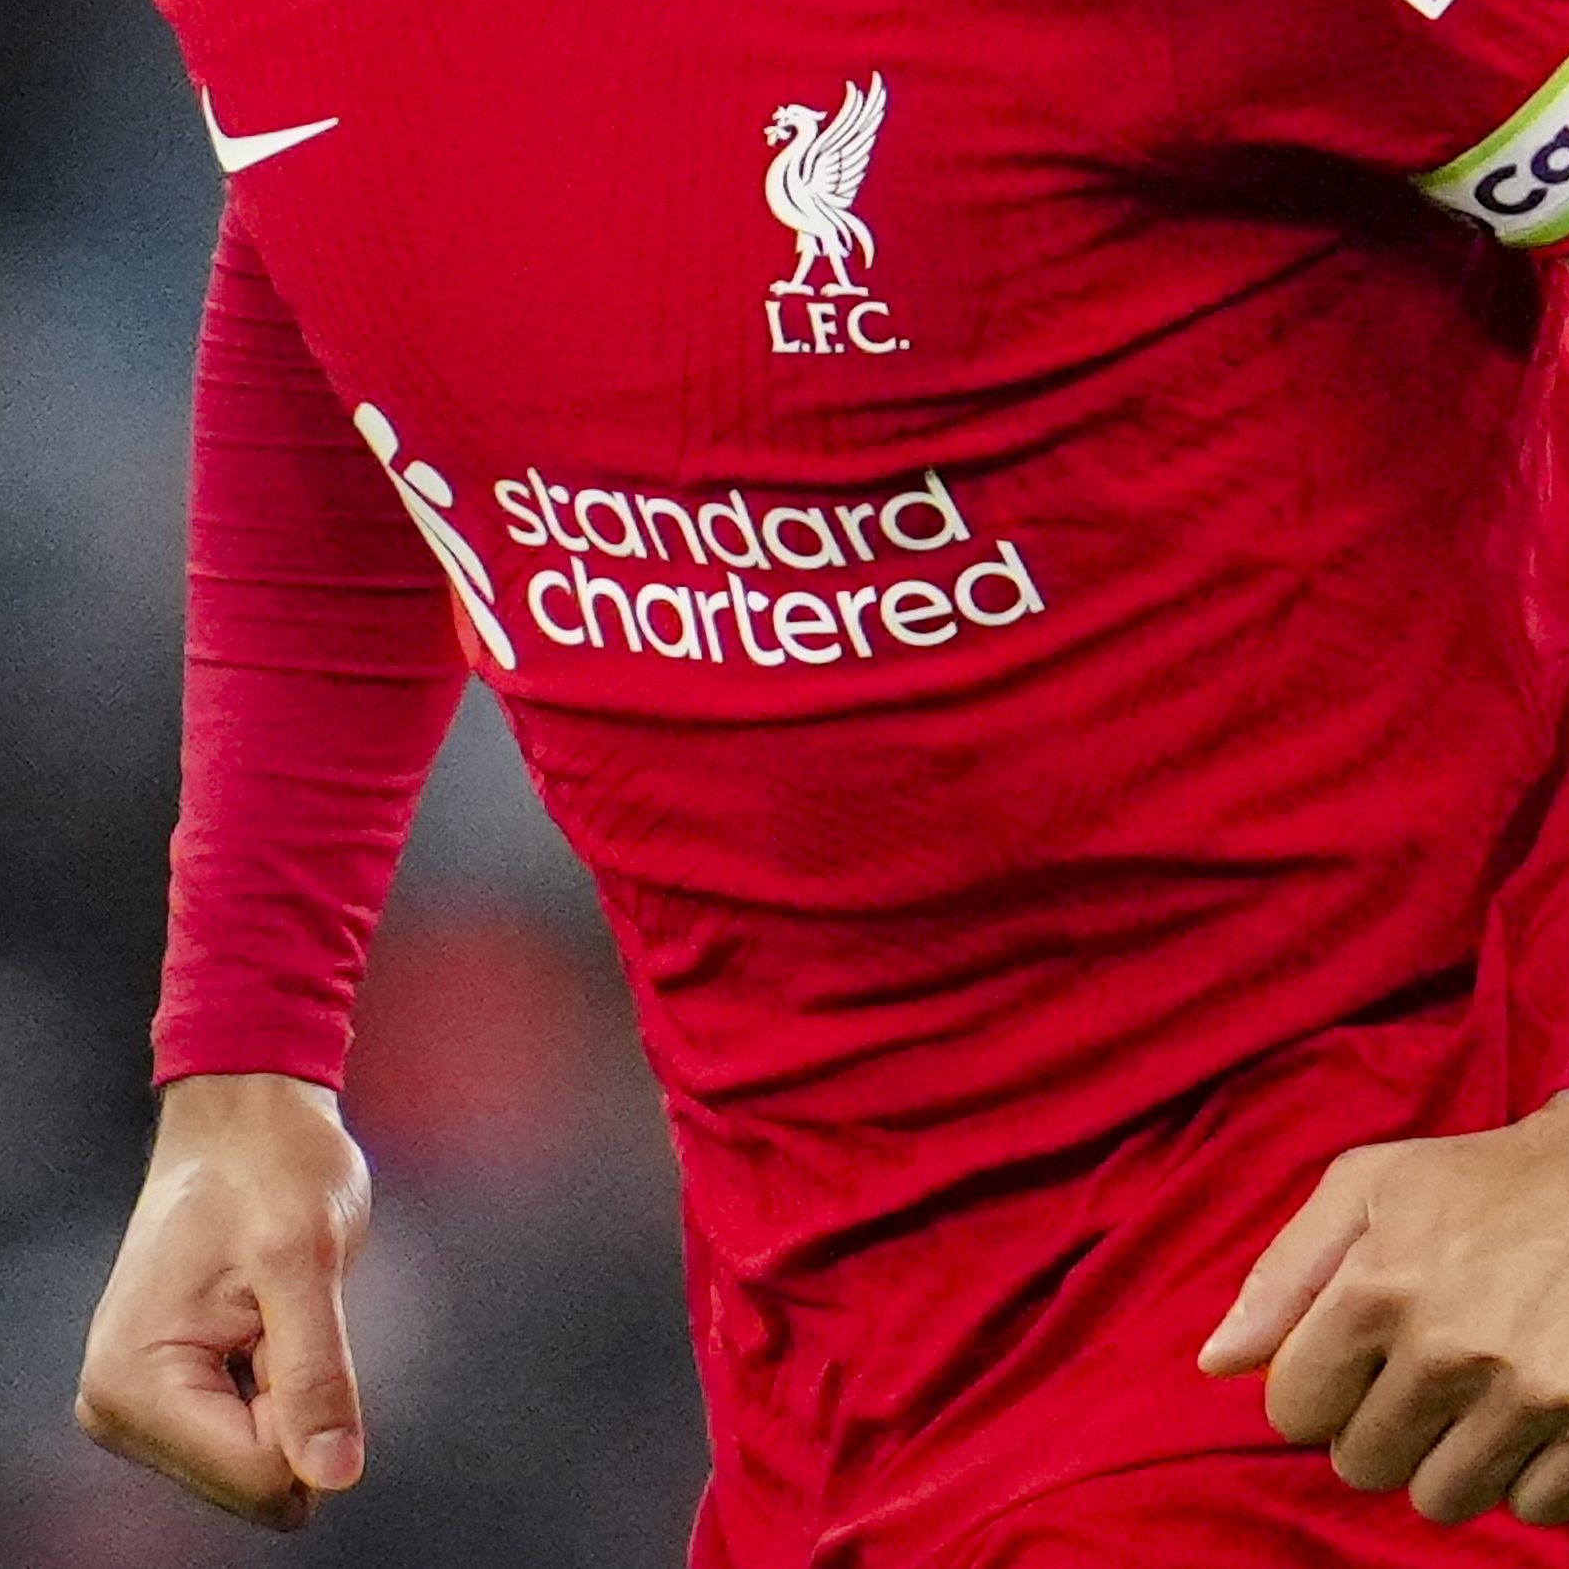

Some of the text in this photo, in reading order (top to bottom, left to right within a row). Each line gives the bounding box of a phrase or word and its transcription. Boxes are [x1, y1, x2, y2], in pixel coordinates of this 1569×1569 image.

[765, 300, 910, 354] L.F.C.
[494, 467, 971, 570] standard
[527, 540, 1045, 667] chartered
